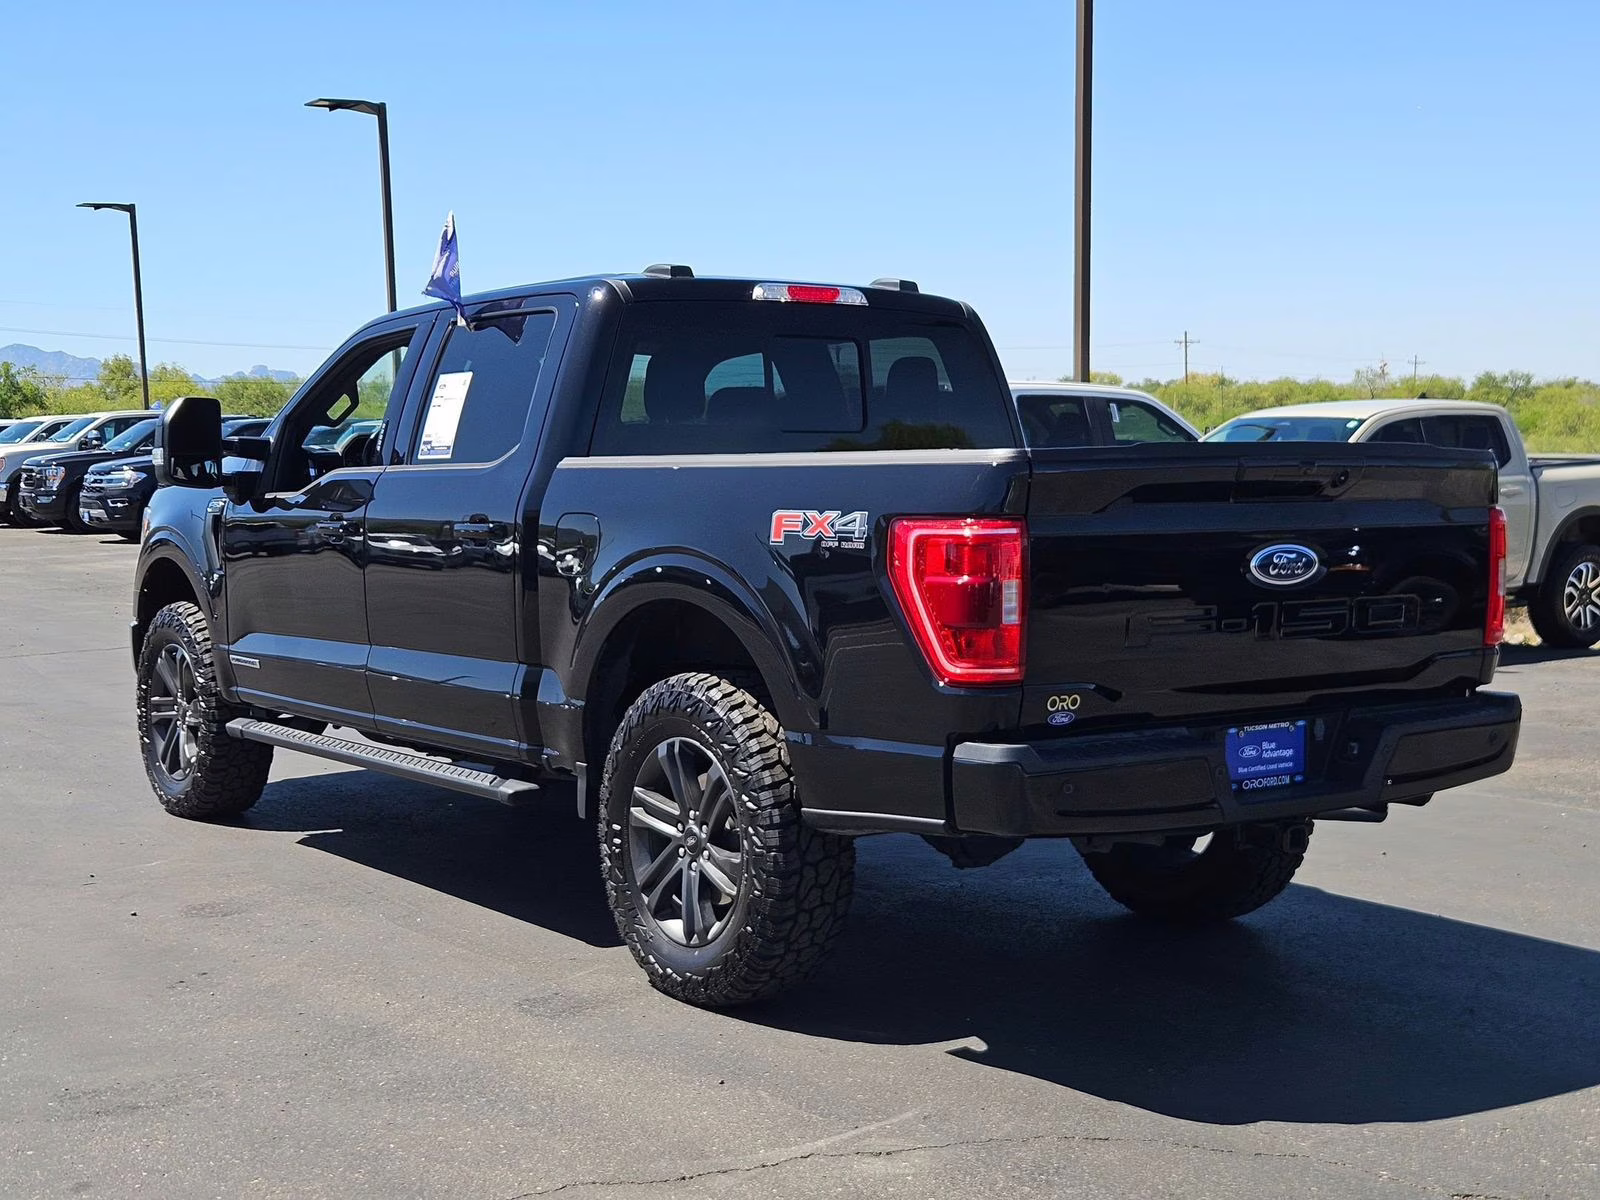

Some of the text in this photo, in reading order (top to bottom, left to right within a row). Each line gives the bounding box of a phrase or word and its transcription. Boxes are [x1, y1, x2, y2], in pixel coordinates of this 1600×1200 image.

[770, 509, 868, 545] FX4
[1122, 594, 1420, 648] F-150
[1047, 694, 1080, 711] ORO
[1261, 741, 1276, 750] Blue
[1261, 748, 1294, 759] Advantage
